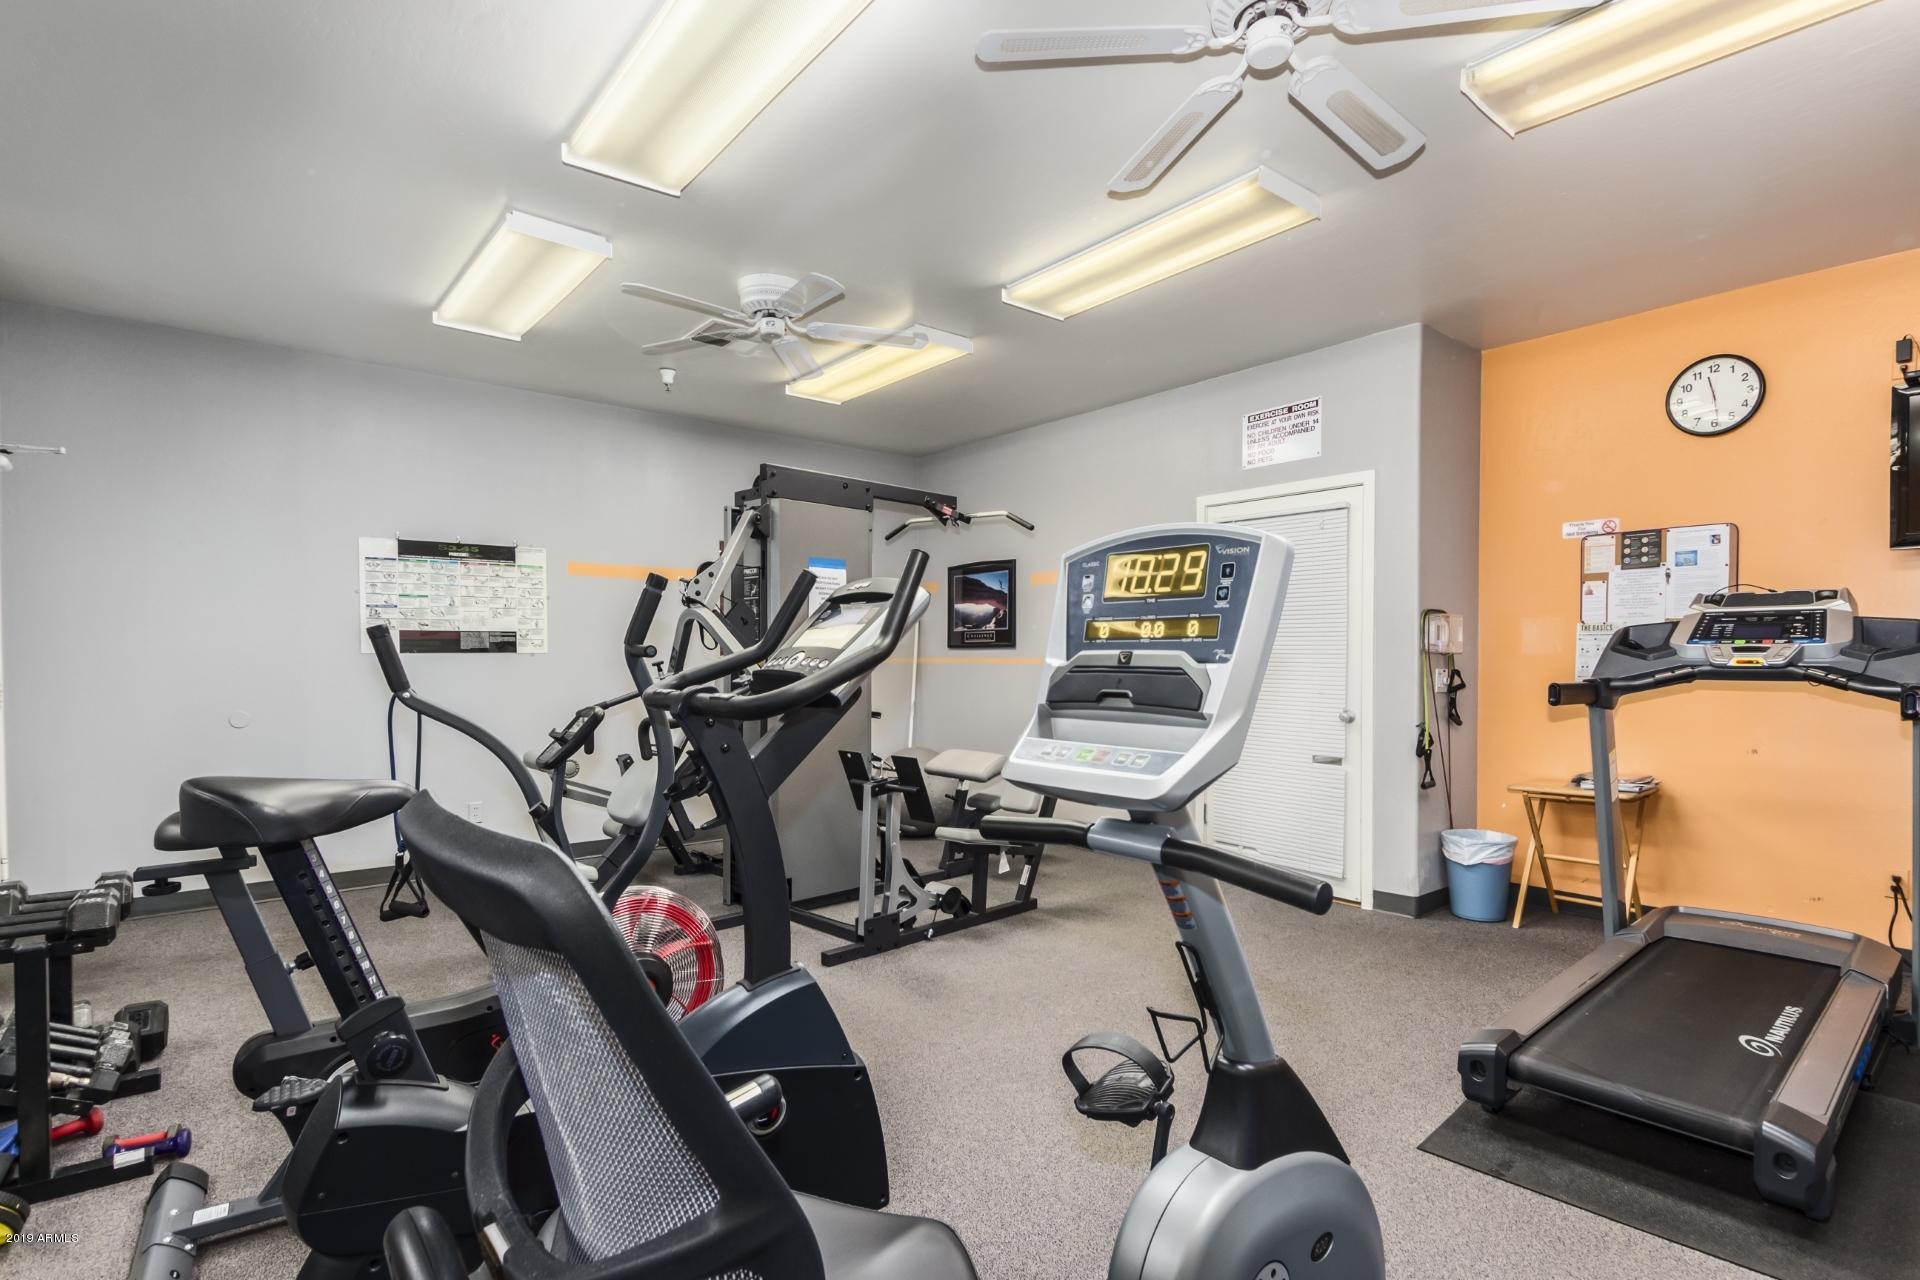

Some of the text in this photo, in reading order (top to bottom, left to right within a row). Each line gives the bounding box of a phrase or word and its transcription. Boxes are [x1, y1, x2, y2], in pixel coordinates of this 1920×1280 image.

[1708, 364, 1720, 373] 12
[1730, 365, 1735, 374] 1
[1693, 372, 1702, 380] 11
[1741, 373, 1749, 382] 2
[1681, 384, 1692, 393] 10
[1747, 385, 1754, 394] 3
[1741, 399, 1748, 408] 4
[1249, 400, 1316, 422] EXERCISE ROOM
[1729, 412, 1736, 420] 5
[1247, 422, 1270, 430] EXERCISE
[1694, 417, 1700, 426] 7
[1711, 419, 1718, 428] 6
[1258, 426, 1286, 436] CHILDREN
[1289, 420, 1310, 429] UNDER
[1248, 426, 1316, 445] UNLESS ACCOMPANIED
[1223, 546, 1250, 554] VISION
[1099, 623, 1110, 638] 0
[1187, 620, 1200, 637] 0
[1592, 624, 1613, 632] BASICS
[326, 885, 332, 894] 5
[334, 900, 340, 909] 6
[341, 916, 346, 924] 7
[348, 931, 354, 939] 8
[356, 946, 362, 954] 9
[362, 960, 370, 970] 10
[368, 975, 376, 984] 11
[376, 990, 384, 1000] 12
[1764, 1006, 1803, 1044] NAUTILUS
